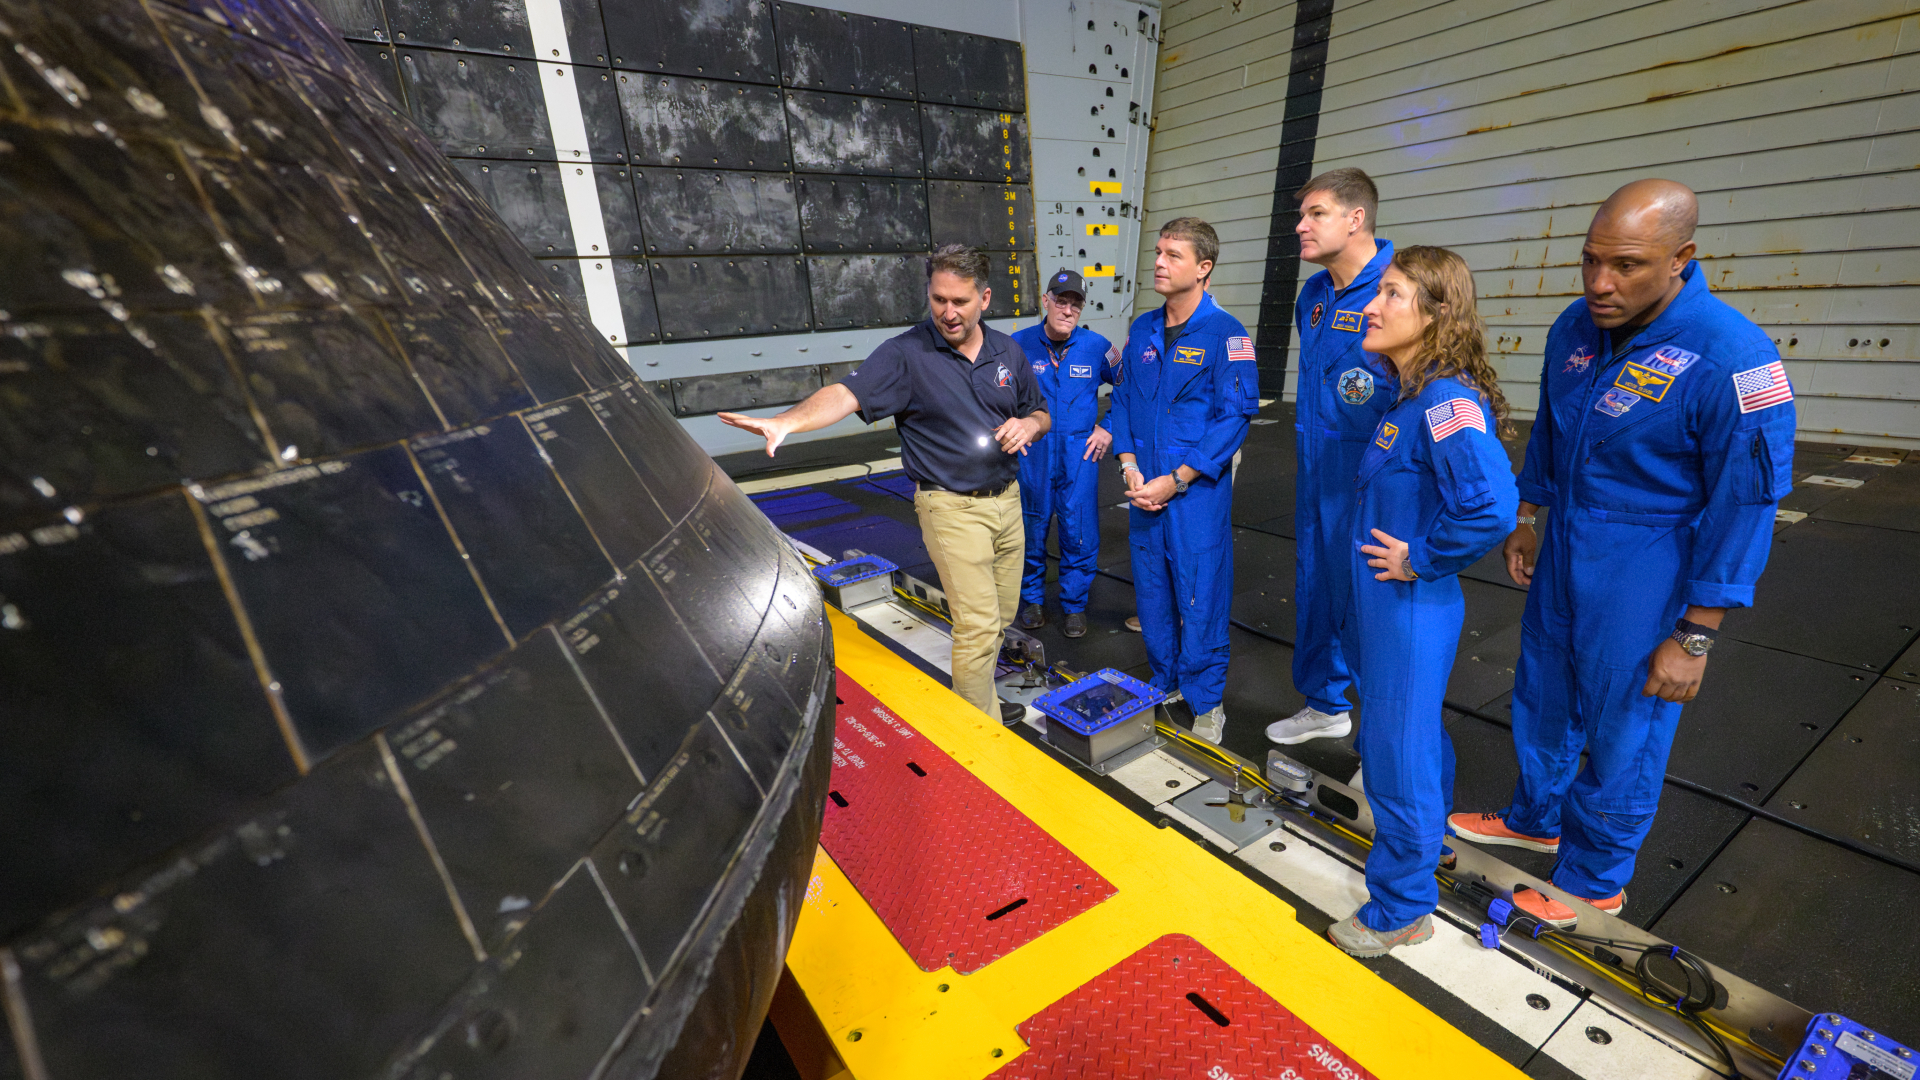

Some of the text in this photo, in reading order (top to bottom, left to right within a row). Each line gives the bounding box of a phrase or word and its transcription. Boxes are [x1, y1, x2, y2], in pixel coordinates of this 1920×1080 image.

[1003, 129, 1008, 139] 8
[1004, 145, 1009, 154] 6
[1005, 161, 1010, 170] 4
[1004, 191, 1016, 200] 3M
[1008, 206, 1013, 215] 8
[1055, 202, 1062, 214] 9
[1009, 221, 1014, 230] 6
[1056, 224, 1063, 235] 8
[1010, 236, 1015, 245] 4
[1058, 245, 1064, 257] 7
[1011, 252, 1016, 260] 2
[1009, 265, 1020, 274] 2M
[1013, 280, 1018, 289] 8
[1014, 294, 1019, 303] 6
[1015, 308, 1020, 317] 4
[1013, 322, 1017, 330] 2
